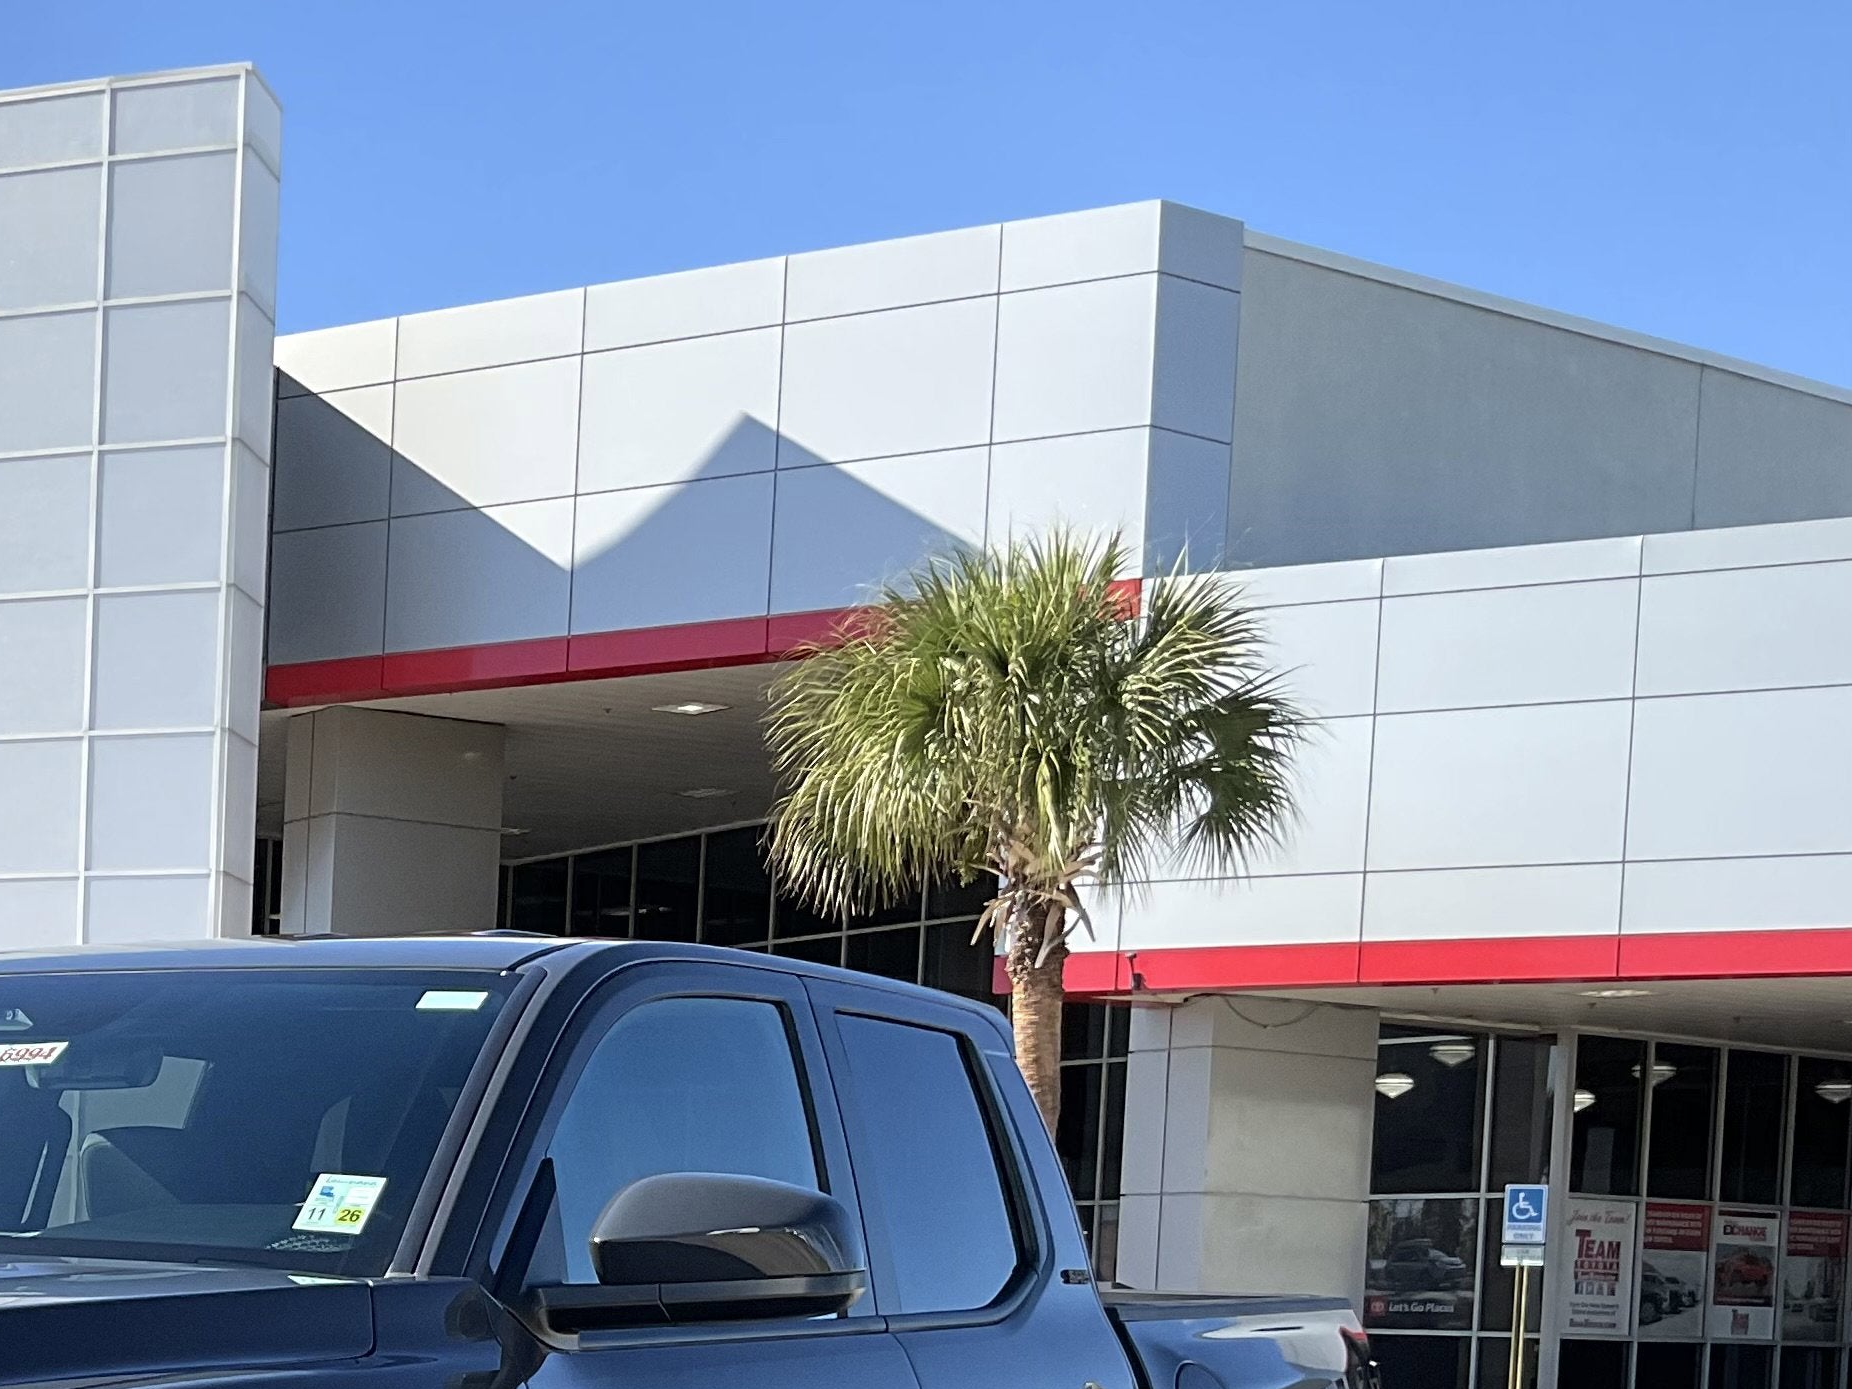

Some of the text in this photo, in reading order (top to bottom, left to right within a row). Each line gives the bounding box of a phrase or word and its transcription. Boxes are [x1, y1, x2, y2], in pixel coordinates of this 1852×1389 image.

[308, 1207, 362, 1222] 11 26
[1575, 1229, 1621, 1259] TEAM
[1389, 1301, 1454, 1312] Let's Go Places
